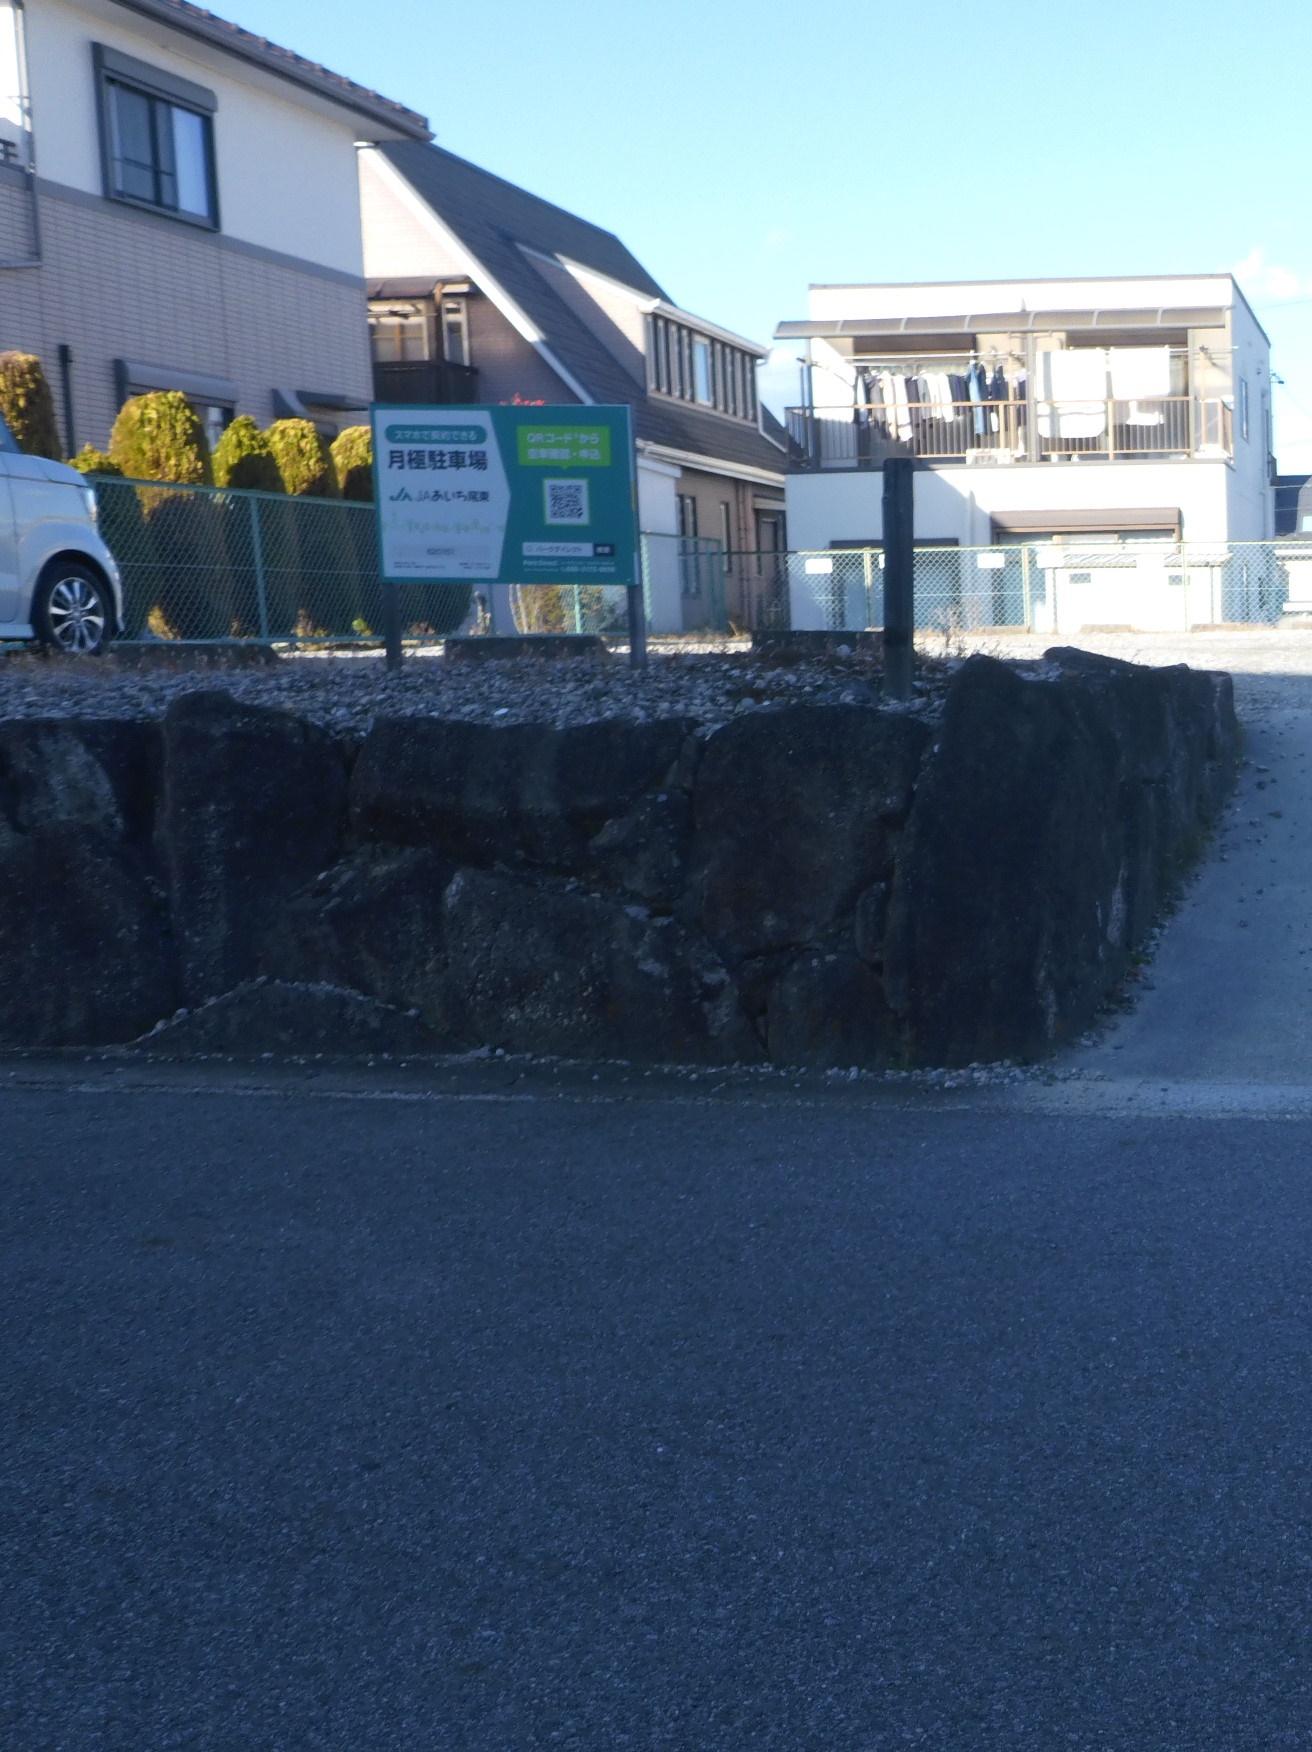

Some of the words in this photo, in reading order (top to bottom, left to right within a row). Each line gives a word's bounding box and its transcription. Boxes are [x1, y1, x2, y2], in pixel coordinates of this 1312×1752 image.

[388, 449, 489, 471] 月極駐車場
